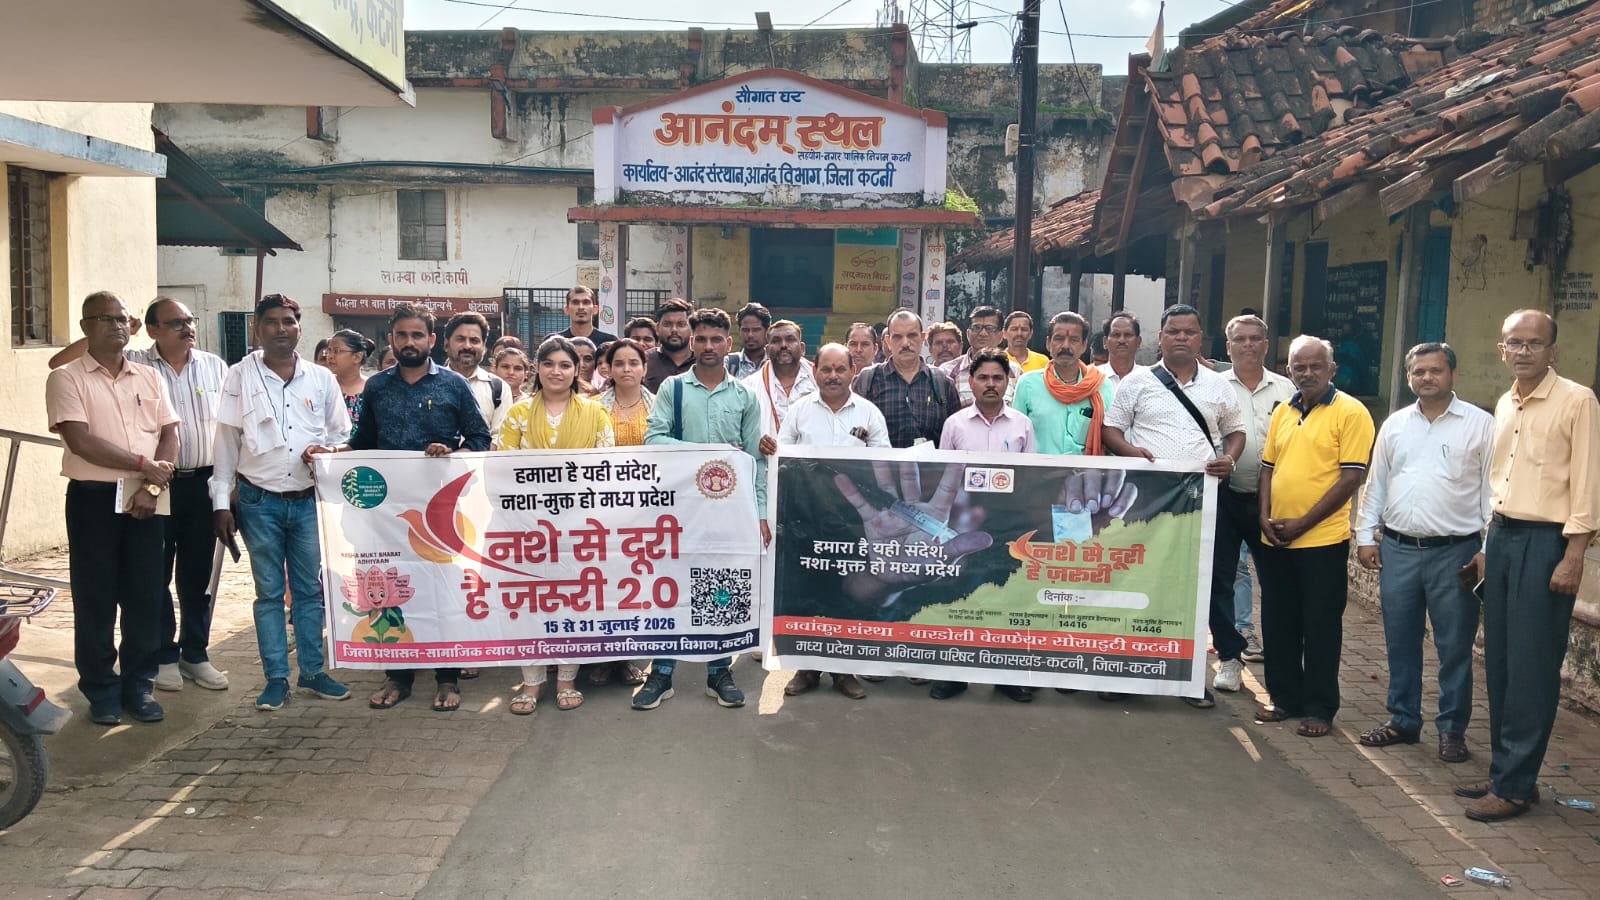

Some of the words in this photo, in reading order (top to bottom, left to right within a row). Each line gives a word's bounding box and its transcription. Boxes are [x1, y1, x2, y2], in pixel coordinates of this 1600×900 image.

[735, 86, 775, 103] सौगात
[796, 111, 887, 150] स्थल
[824, 162, 855, 187] जिला
[856, 162, 896, 188] कटनी
[513, 466, 563, 484] हमारा
[565, 461, 578, 483] है
[581, 460, 611, 482] यही
[614, 459, 662, 484] संदेश,
[500, 492, 575, 516] नशा-मुक्त
[578, 487, 597, 509] हो
[599, 490, 636, 509] मध्य
[638, 486, 676, 508] प्रदेश
[485, 519, 562, 564] नशे
[569, 517, 611, 562] से
[617, 514, 684, 576] दूरी
[812, 540, 855, 555] हमारा
[857, 538, 869, 557] है
[872, 539, 901, 558] यही
[904, 541, 949, 561] संदेश,
[1031, 541, 1078, 562] नशे
[1081, 541, 1104, 563] से
[1108, 543, 1146, 571] दूरी
[799, 556, 867, 576] नशा-मुक्त
[869, 557, 887, 575] हो
[889, 561, 922, 576] मध्य
[924, 559, 962, 577] प्रदेश
[1025, 560, 1042, 581] है
[460, 568, 491, 620] है
[617, 576, 679, 611] 2.0
[544, 620, 559, 634] 15
[562, 618, 576, 633] से
[579, 619, 594, 632] 31
[598, 616, 641, 635] जुलाई
[644, 617, 676, 631] 2026
[1008, 618, 1031, 627] 1933
[1059, 620, 1088, 629] 14416
[1131, 625, 1162, 634] 14446
[785, 620, 842, 637] नवांकुर
[847, 621, 893, 637] संस्था
[1052, 633, 1127, 652] सोसाइटी
[1131, 639, 1181, 654] कटनी
[342, 643, 373, 658] जिला
[485, 645, 515, 657] न्याय
[517, 641, 537, 657] एवं
[795, 640, 823, 653] मध्य
[826, 640, 854, 656] प्रदेश
[857, 645, 880, 657] जन
[884, 644, 936, 661] अभियान
[939, 647, 975, 664] परिषद
[1092, 656, 1168, 676] जिला-कटनी
